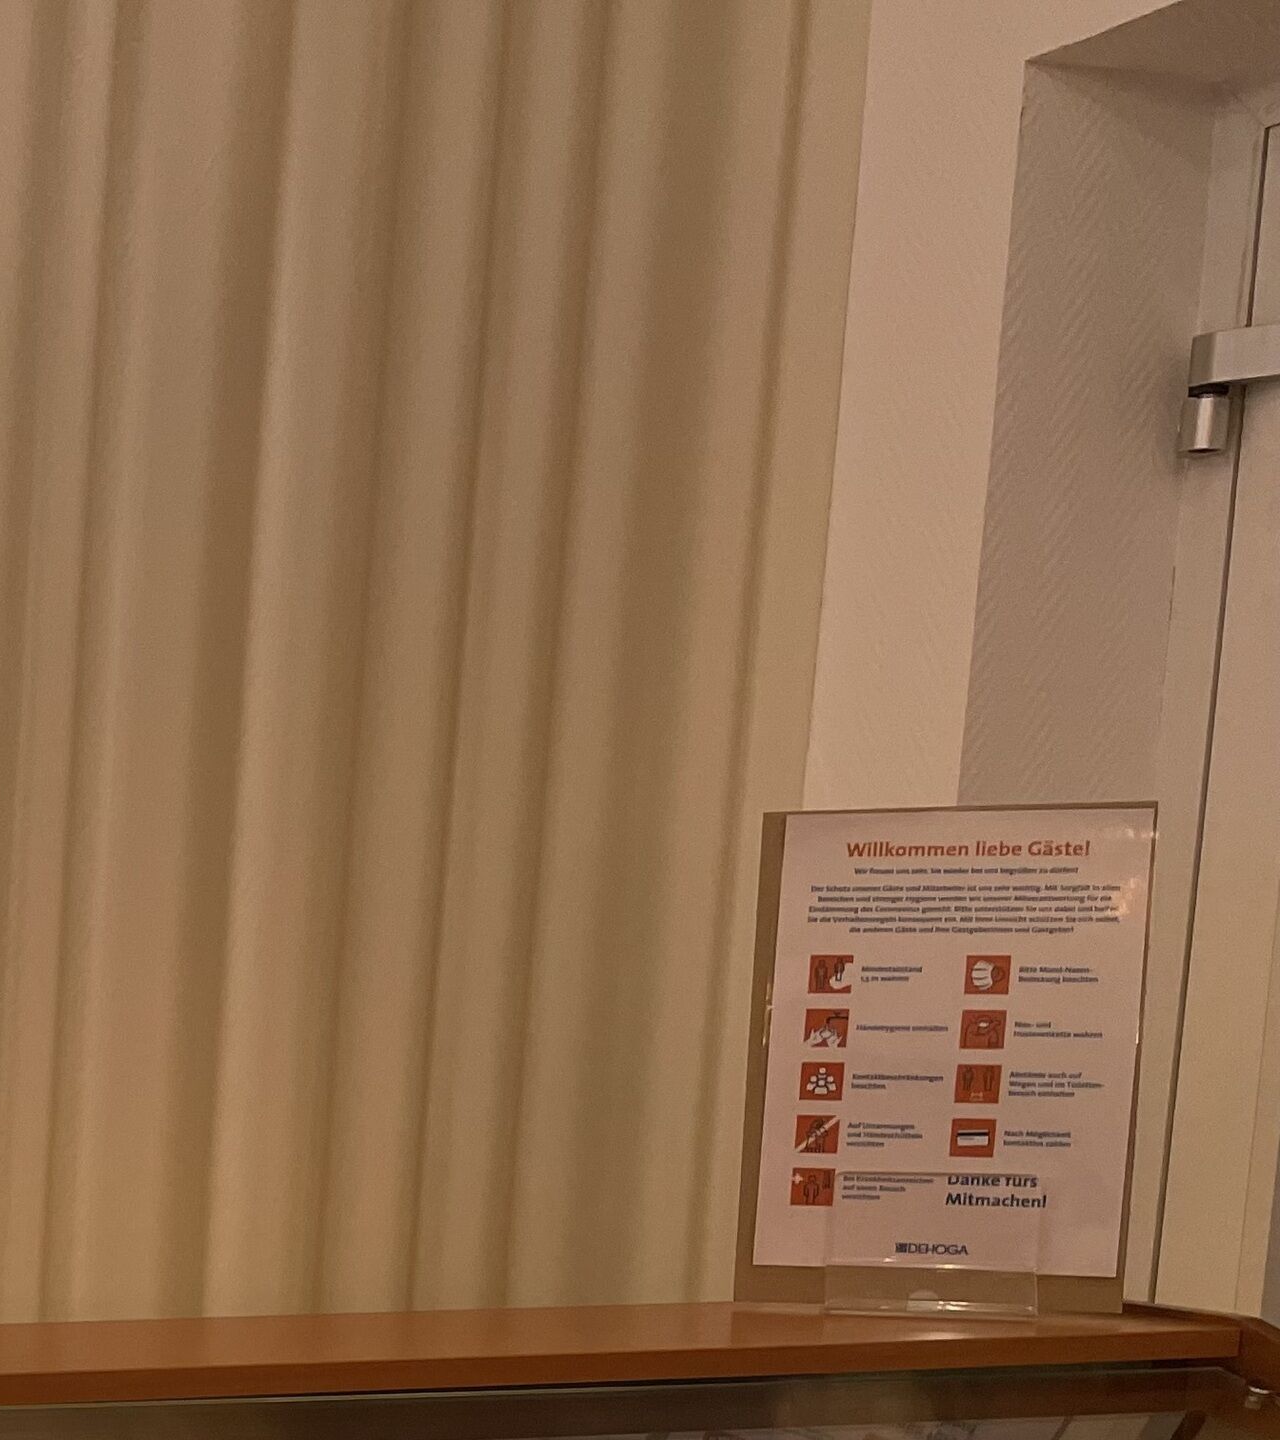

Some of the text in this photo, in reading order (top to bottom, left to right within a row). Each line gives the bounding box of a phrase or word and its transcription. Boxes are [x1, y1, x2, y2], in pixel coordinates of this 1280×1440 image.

[847, 839, 1090, 857] Willkommen liebe Gäste!
[948, 1174, 1001, 1187] Danke
[945, 1192, 1047, 1209] Mitmachen!
[907, 1242, 969, 1256] DEHOGA
